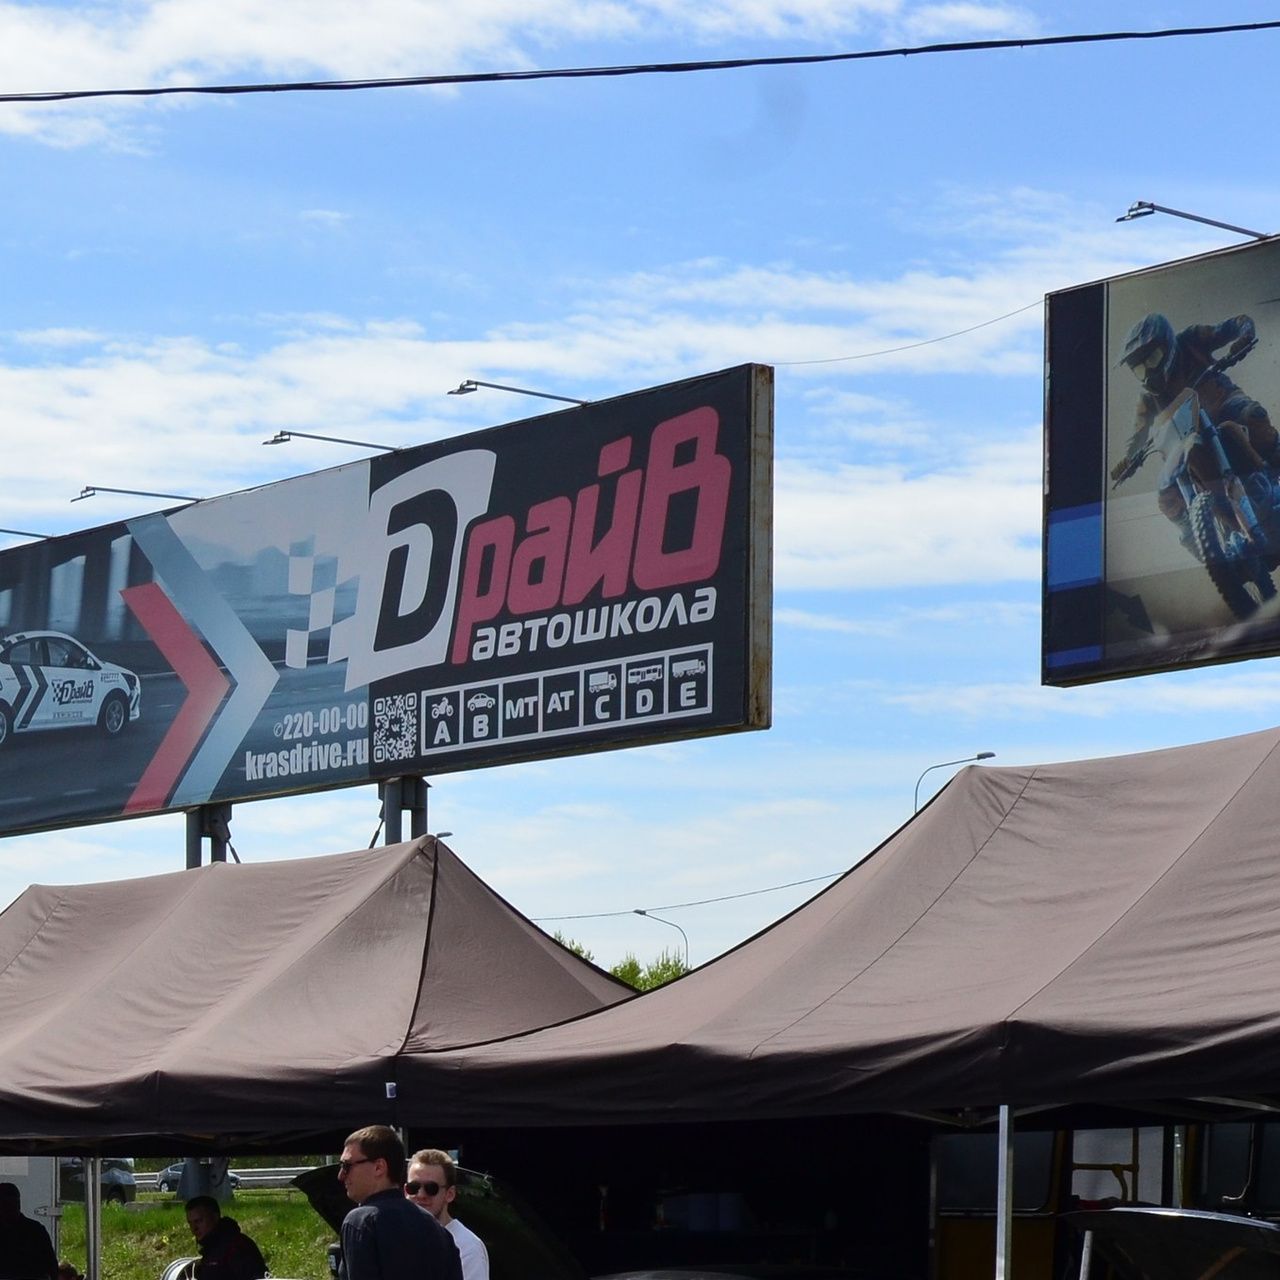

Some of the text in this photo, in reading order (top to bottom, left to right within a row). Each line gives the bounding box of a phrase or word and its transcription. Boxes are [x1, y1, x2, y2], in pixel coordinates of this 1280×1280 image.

[636, 689, 653, 713] D
[283, 702, 368, 740] 220-00-00
[245, 738, 369, 781] krasdrive.ru
